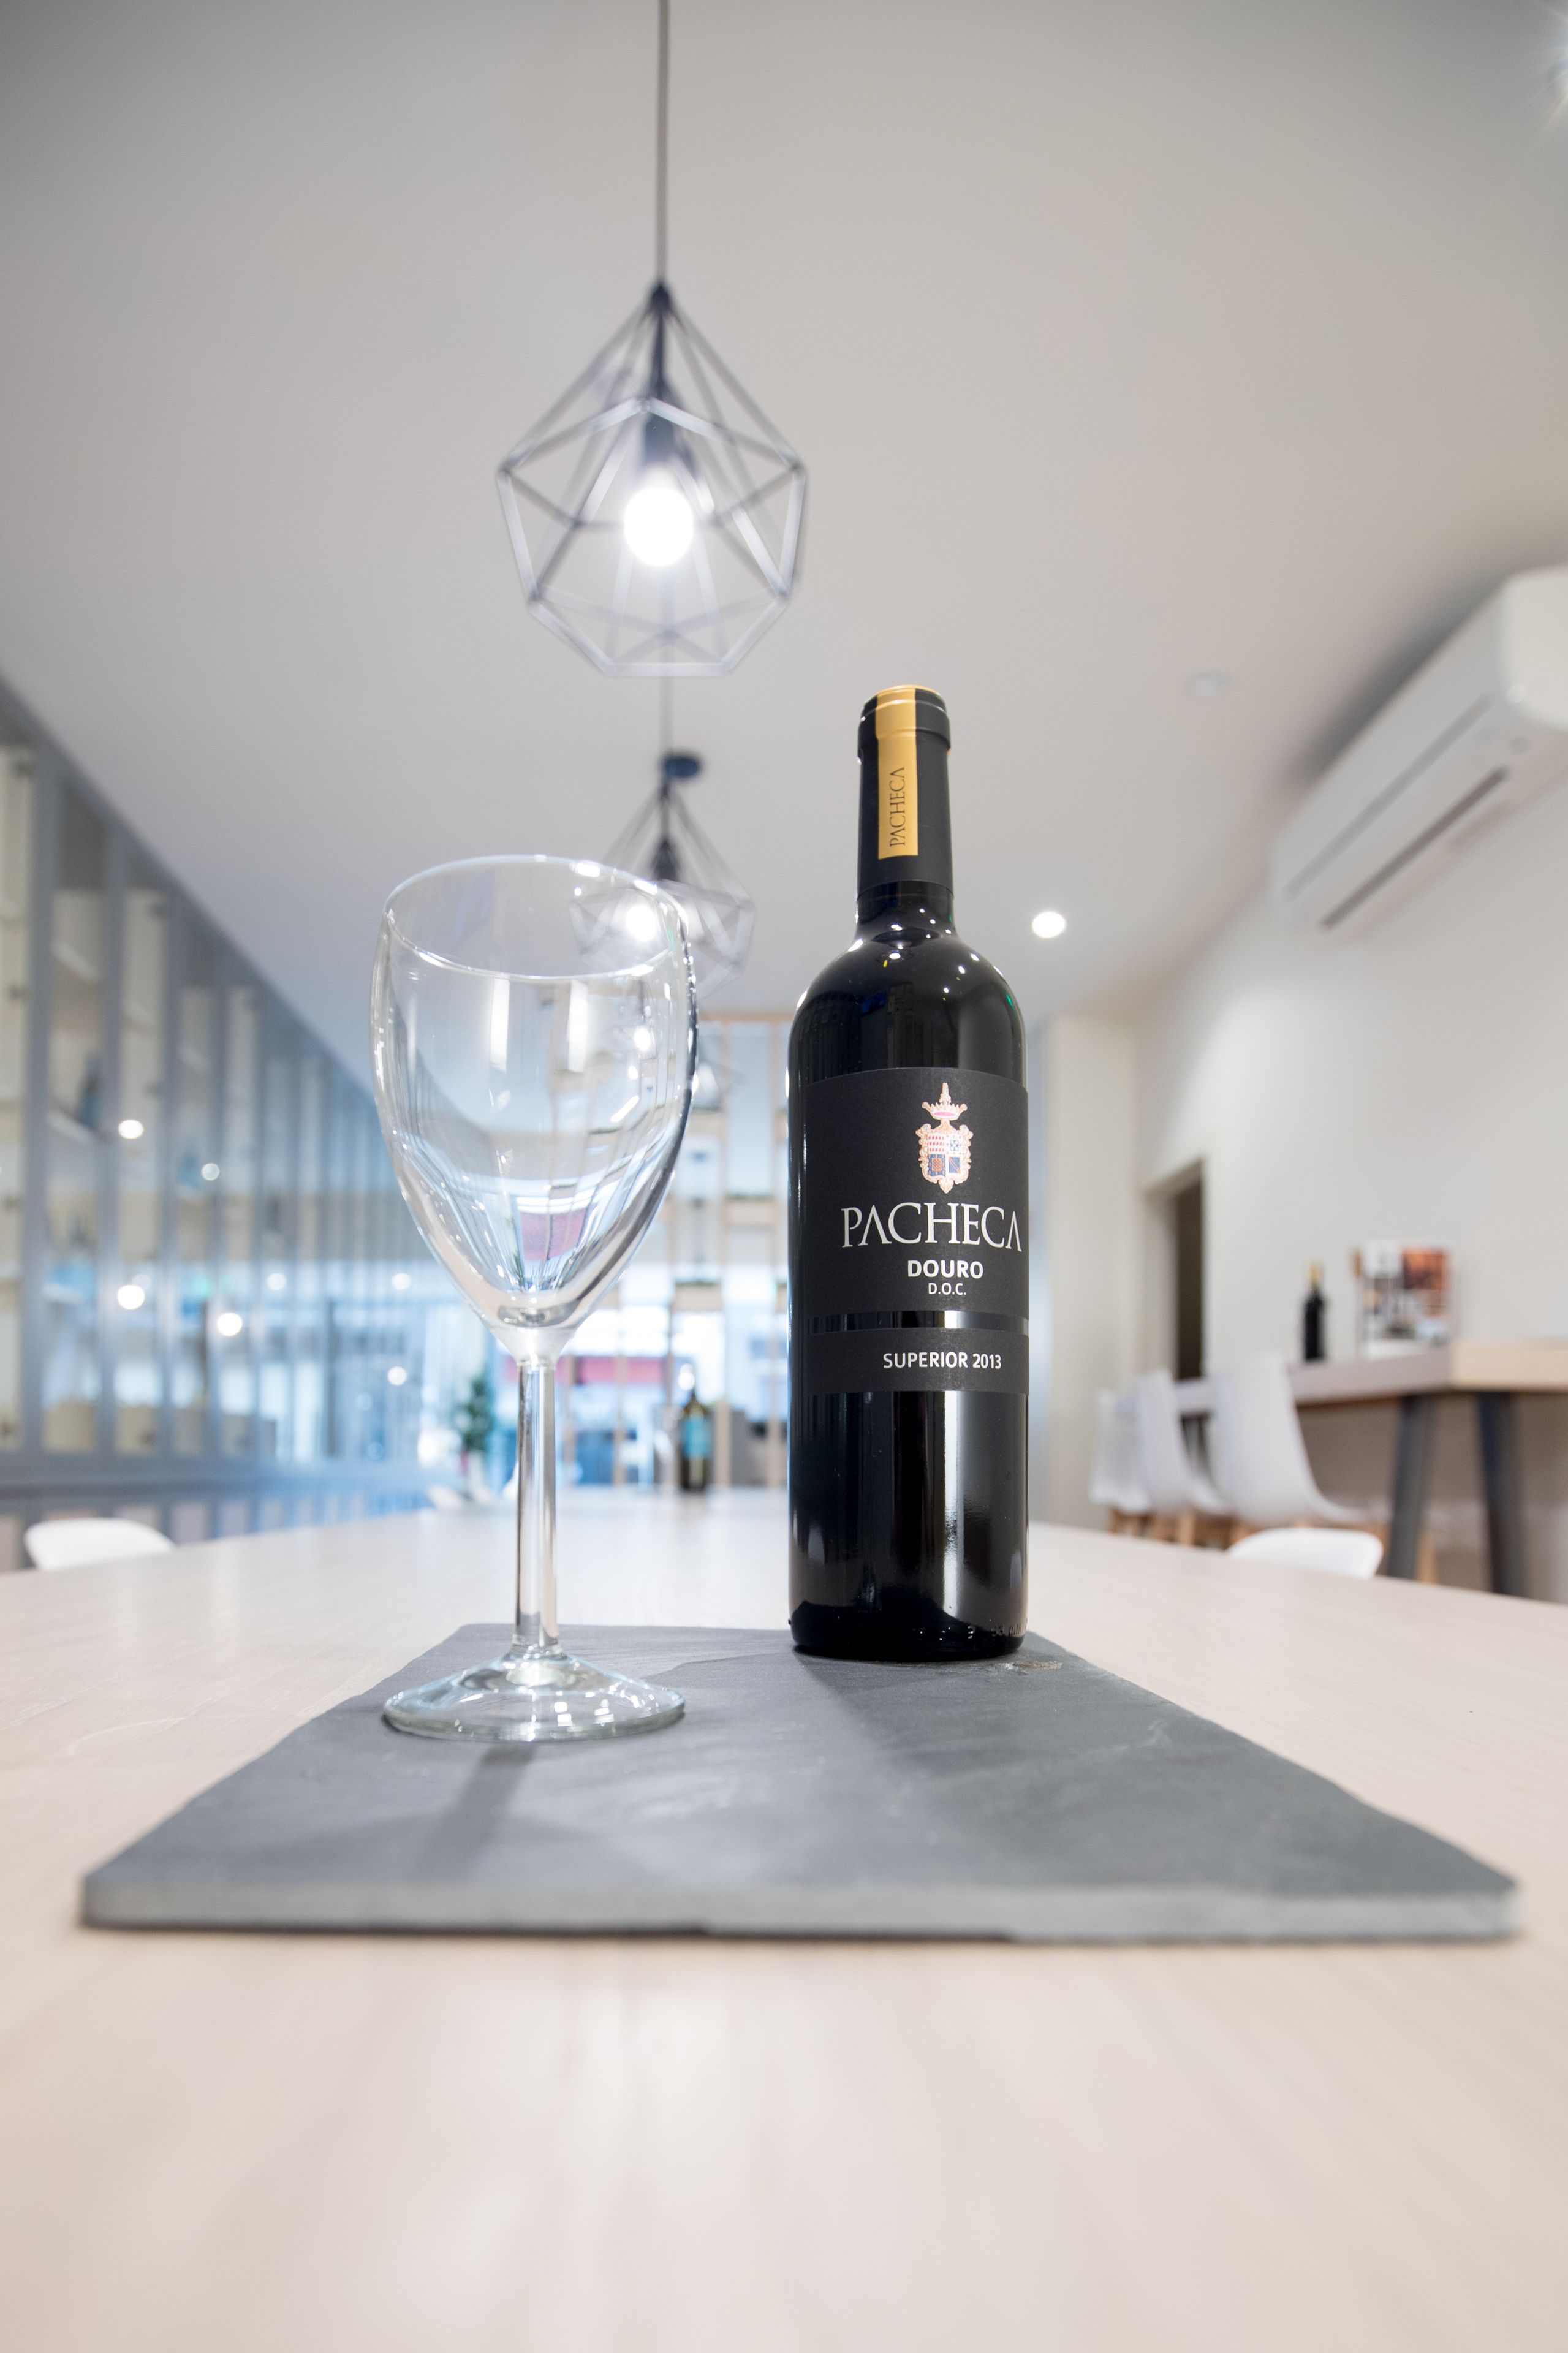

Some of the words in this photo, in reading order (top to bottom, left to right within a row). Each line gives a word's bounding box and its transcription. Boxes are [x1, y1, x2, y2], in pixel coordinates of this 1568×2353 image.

[889, 766, 906, 847] PACHECA
[841, 1202, 1023, 1252] PACHECA
[907, 1259, 983, 1279] DOURO
[928, 1282, 966, 1295] D.O.C.
[883, 1351, 968, 1370] SUPERIOR
[972, 1353, 1002, 1370] 2013
